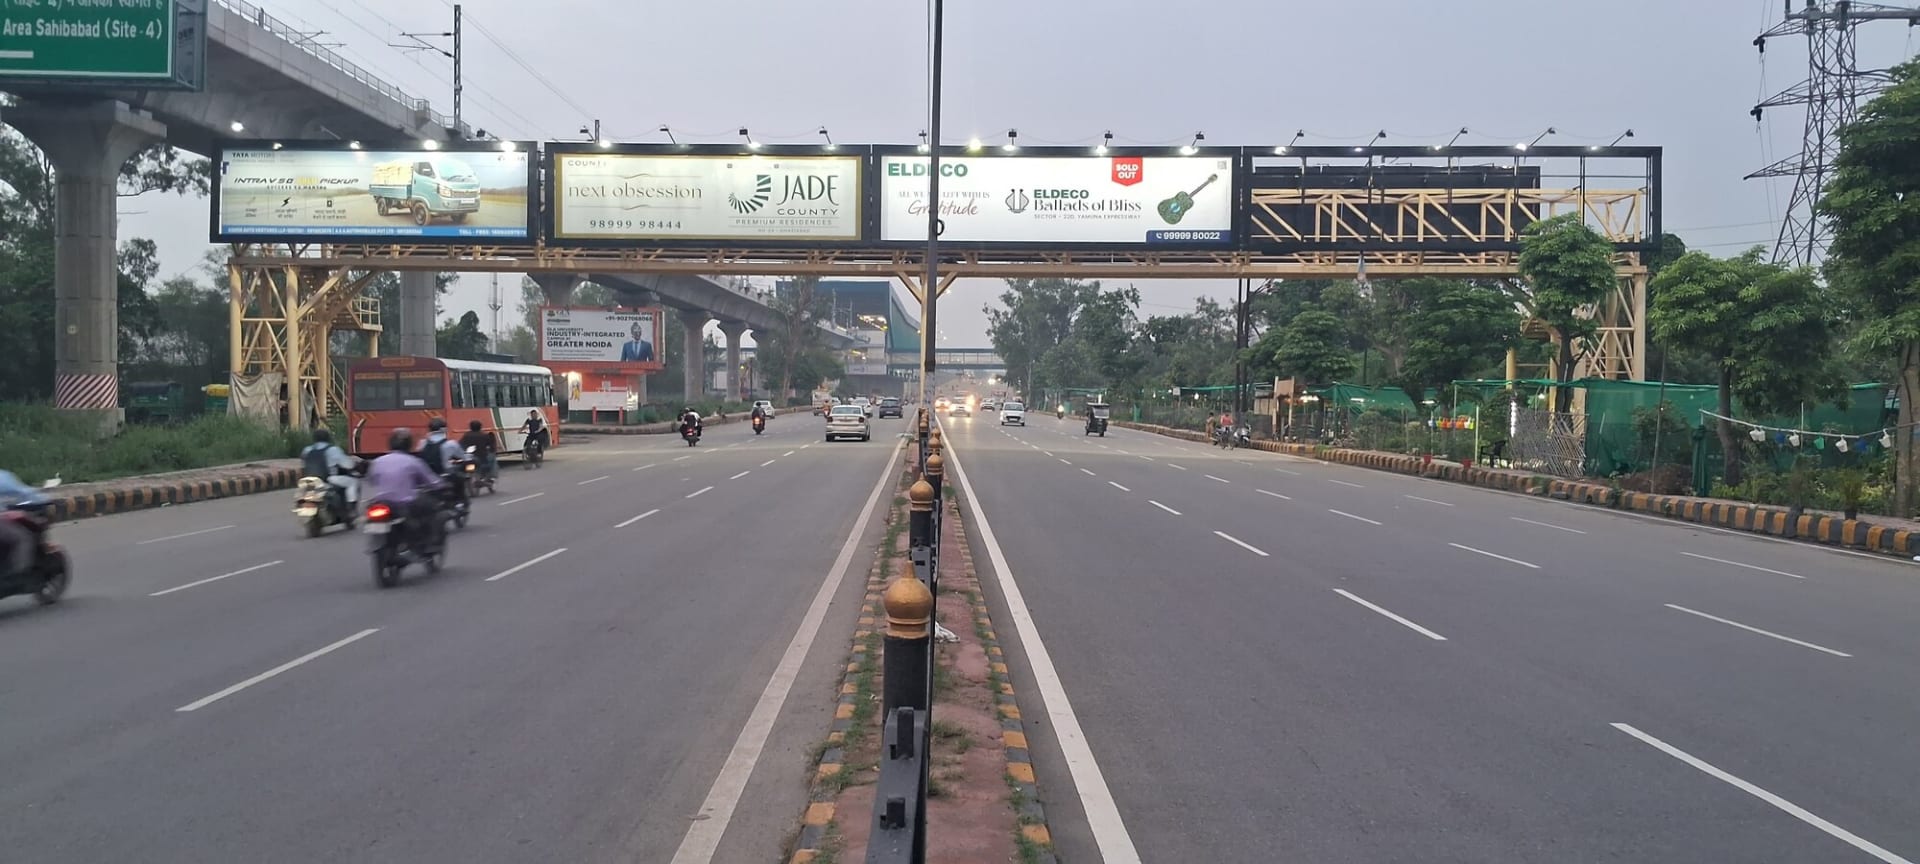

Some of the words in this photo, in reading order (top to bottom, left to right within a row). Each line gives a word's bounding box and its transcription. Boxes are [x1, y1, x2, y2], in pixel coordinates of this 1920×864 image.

[3, 18, 32, 35] Area
[35, 18, 100, 38] Sahibabad
[105, 17, 137, 39] (Site
[145, 18, 163, 40] 4)
[1118, 171, 1137, 179] OUT
[569, 185, 606, 198] next
[612, 182, 703, 198] obsession
[776, 175, 839, 206] JADE
[1034, 189, 1089, 199] ELDECO
[908, 196, 978, 216] Grtitude
[1034, 199, 1089, 211] Ballads
[1091, 199, 1107, 211] of
[1109, 199, 1142, 212] Bliss
[777, 208, 839, 216] COUNTY
[590, 219, 632, 229] 98999
[639, 220, 682, 229] 98444
[1163, 232, 1191, 240] 99999
[1192, 232, 1221, 240] 80022
